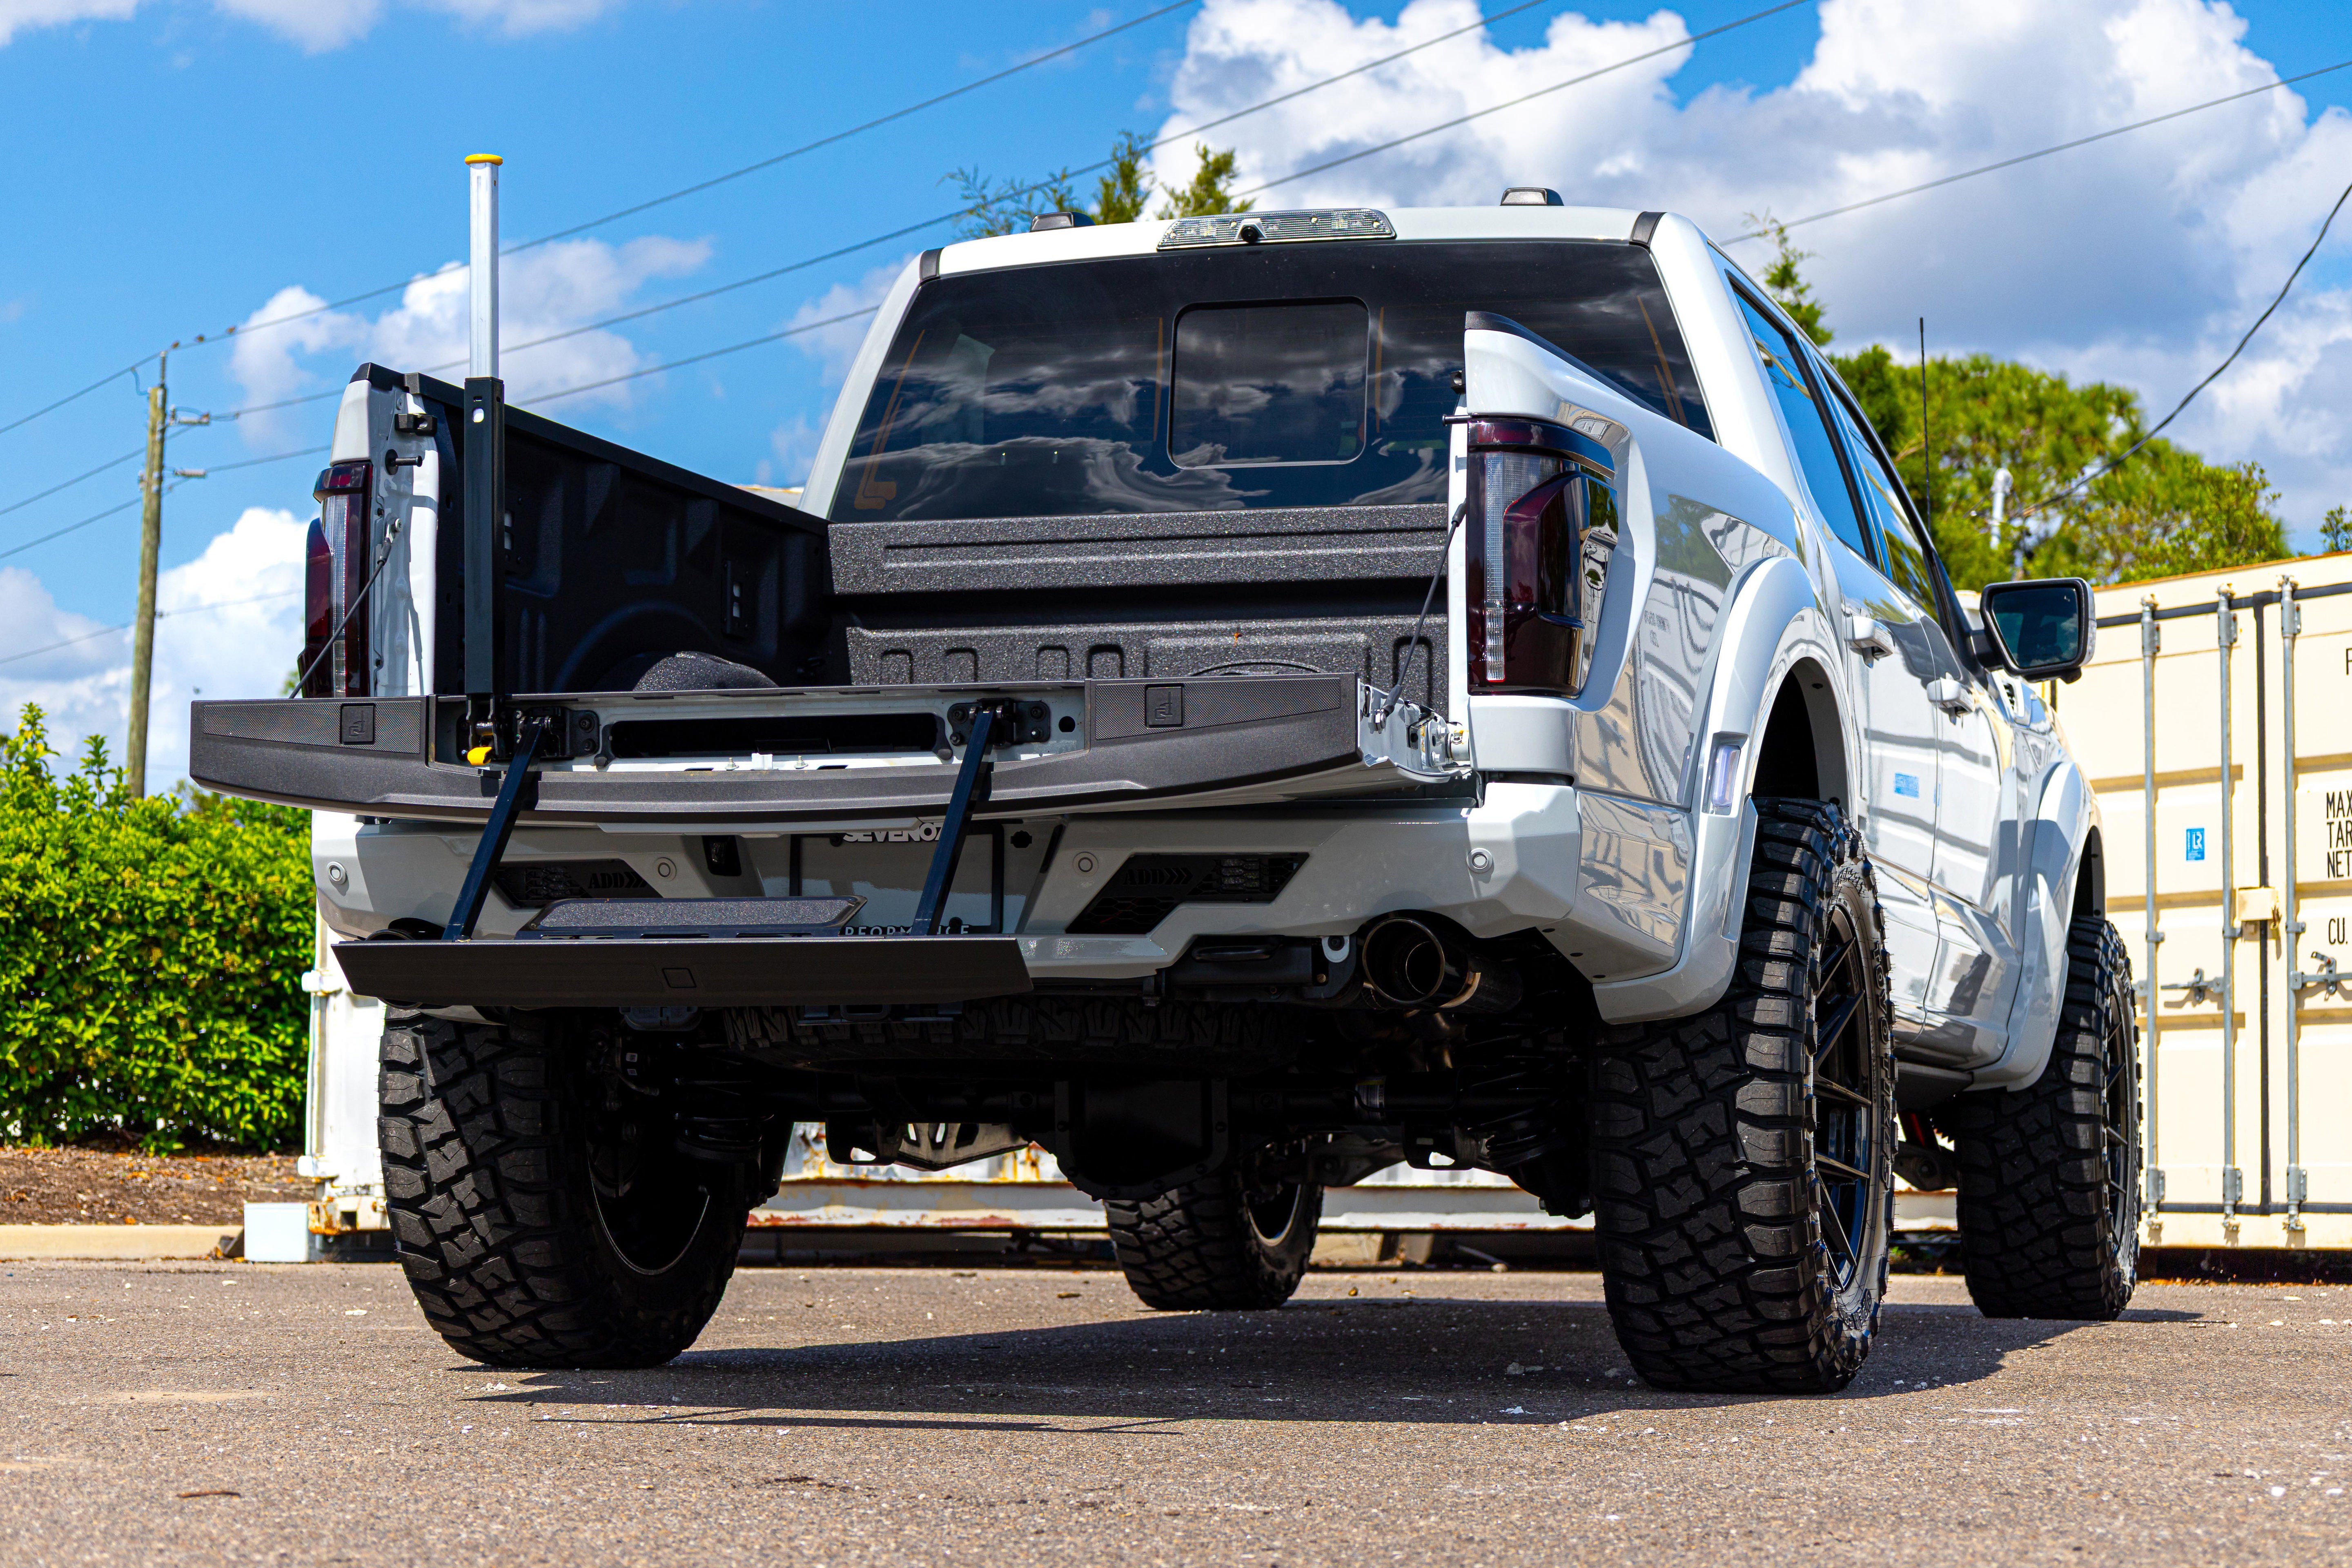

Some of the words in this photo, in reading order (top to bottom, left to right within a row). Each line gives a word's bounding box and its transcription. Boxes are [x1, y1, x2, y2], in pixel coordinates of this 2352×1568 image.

[1123, 869, 1165, 885] ADD
[2328, 850, 2352, 878] NET
[588, 872, 625, 889] ADD
[2328, 917, 2348, 945] CU.
[1871, 940, 1889, 1044] TOYO
